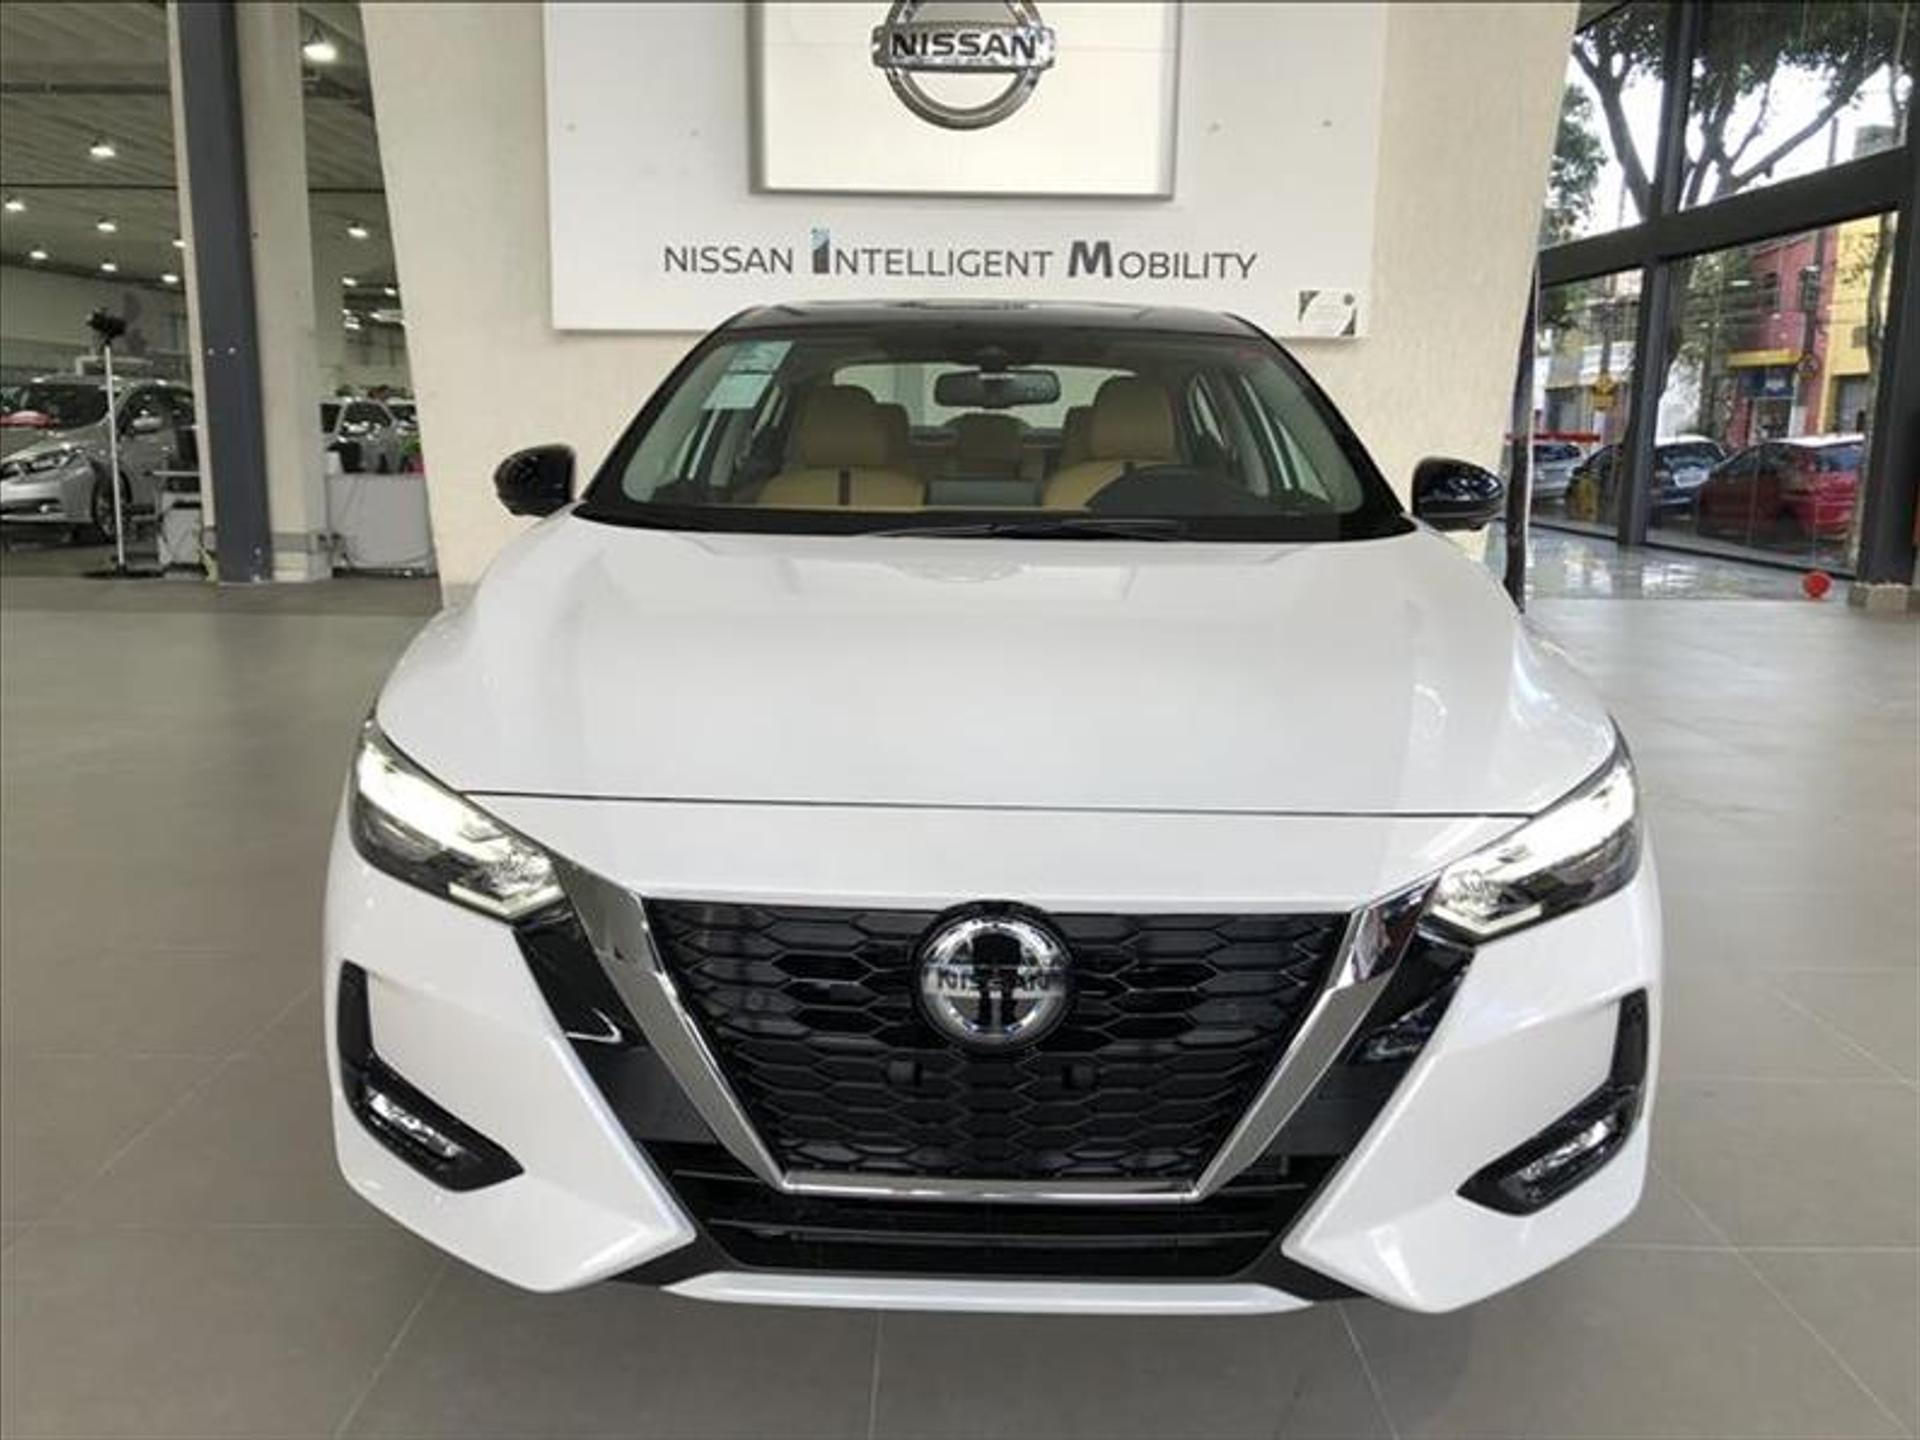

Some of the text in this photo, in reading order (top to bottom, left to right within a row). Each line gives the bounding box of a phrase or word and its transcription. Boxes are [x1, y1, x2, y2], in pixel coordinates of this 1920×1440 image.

[891, 32, 1036, 59] NISSAN
[663, 228, 1257, 279] NISSAN INTELLIGENT MOBILITY
